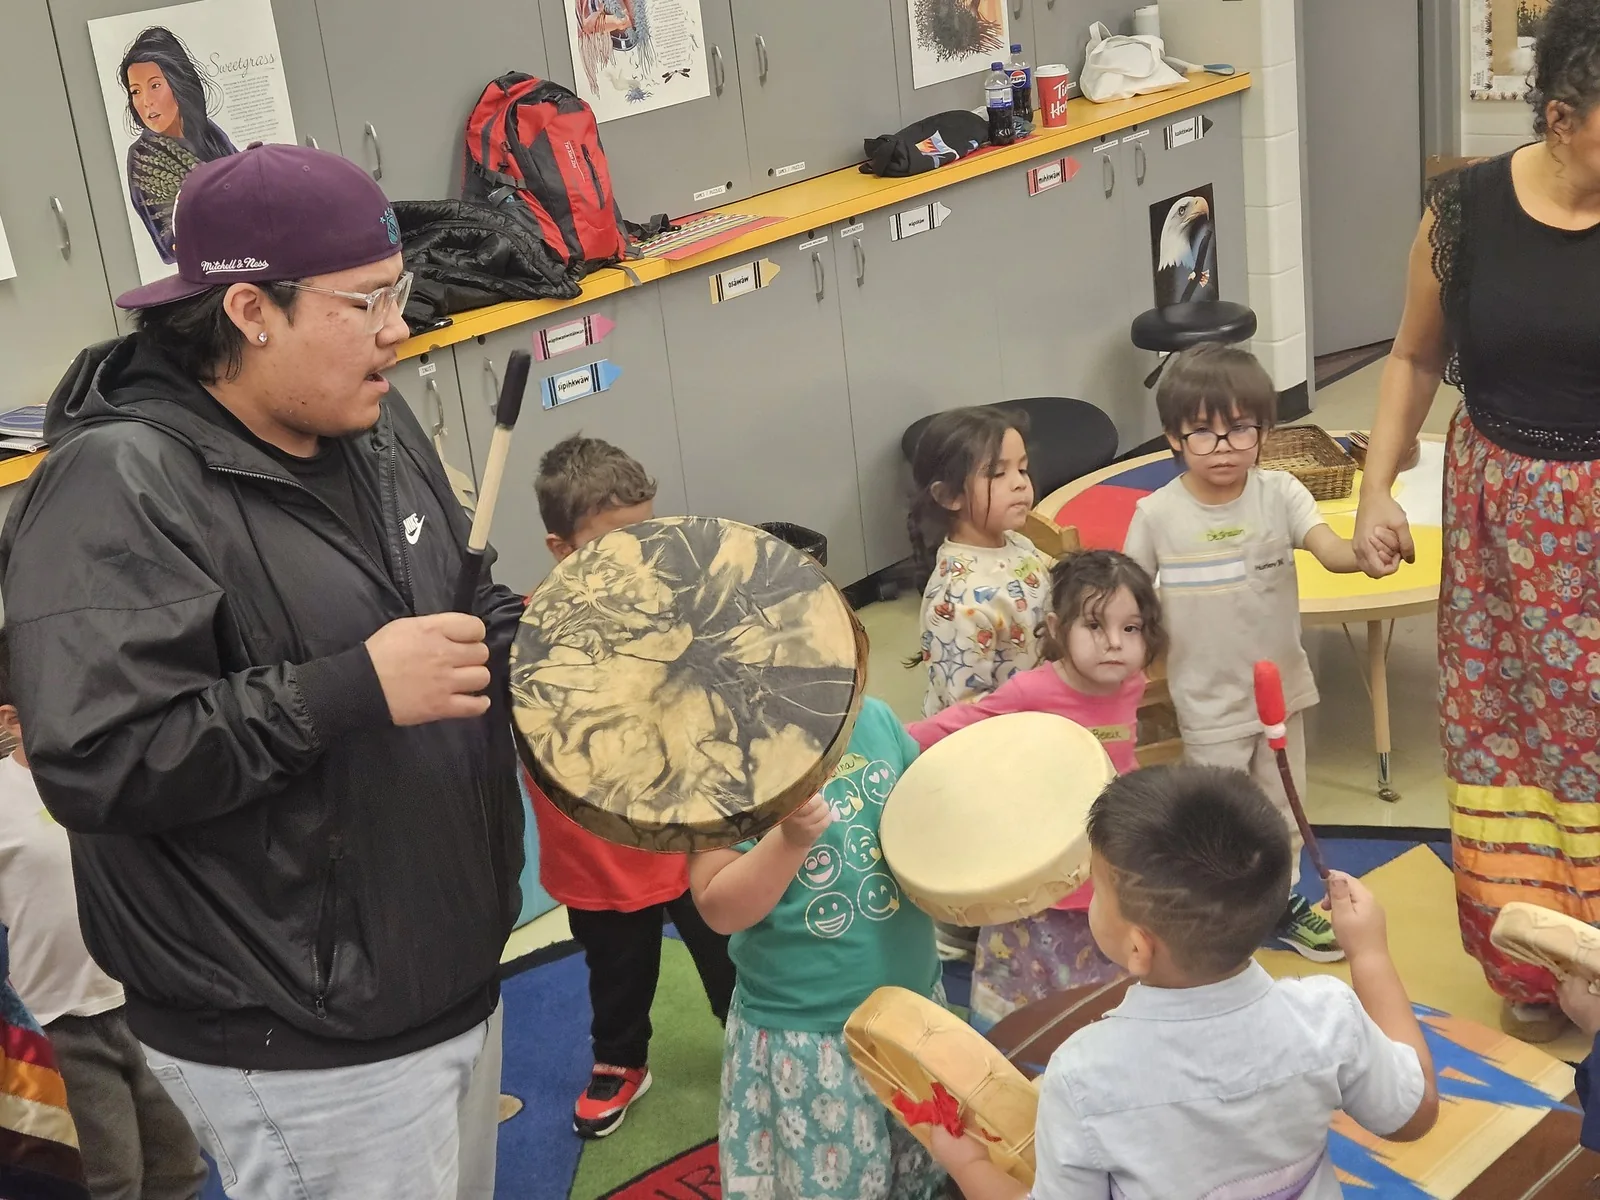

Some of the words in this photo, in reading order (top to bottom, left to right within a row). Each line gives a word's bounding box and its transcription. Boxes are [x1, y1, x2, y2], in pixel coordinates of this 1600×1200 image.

[207, 52, 275, 79] Sweetgrass
[1010, 76, 1026, 84] PEPSI
[201, 259, 236, 271] Mitchell
[237, 259, 244, 269] &
[243, 257, 266, 268] Ness
